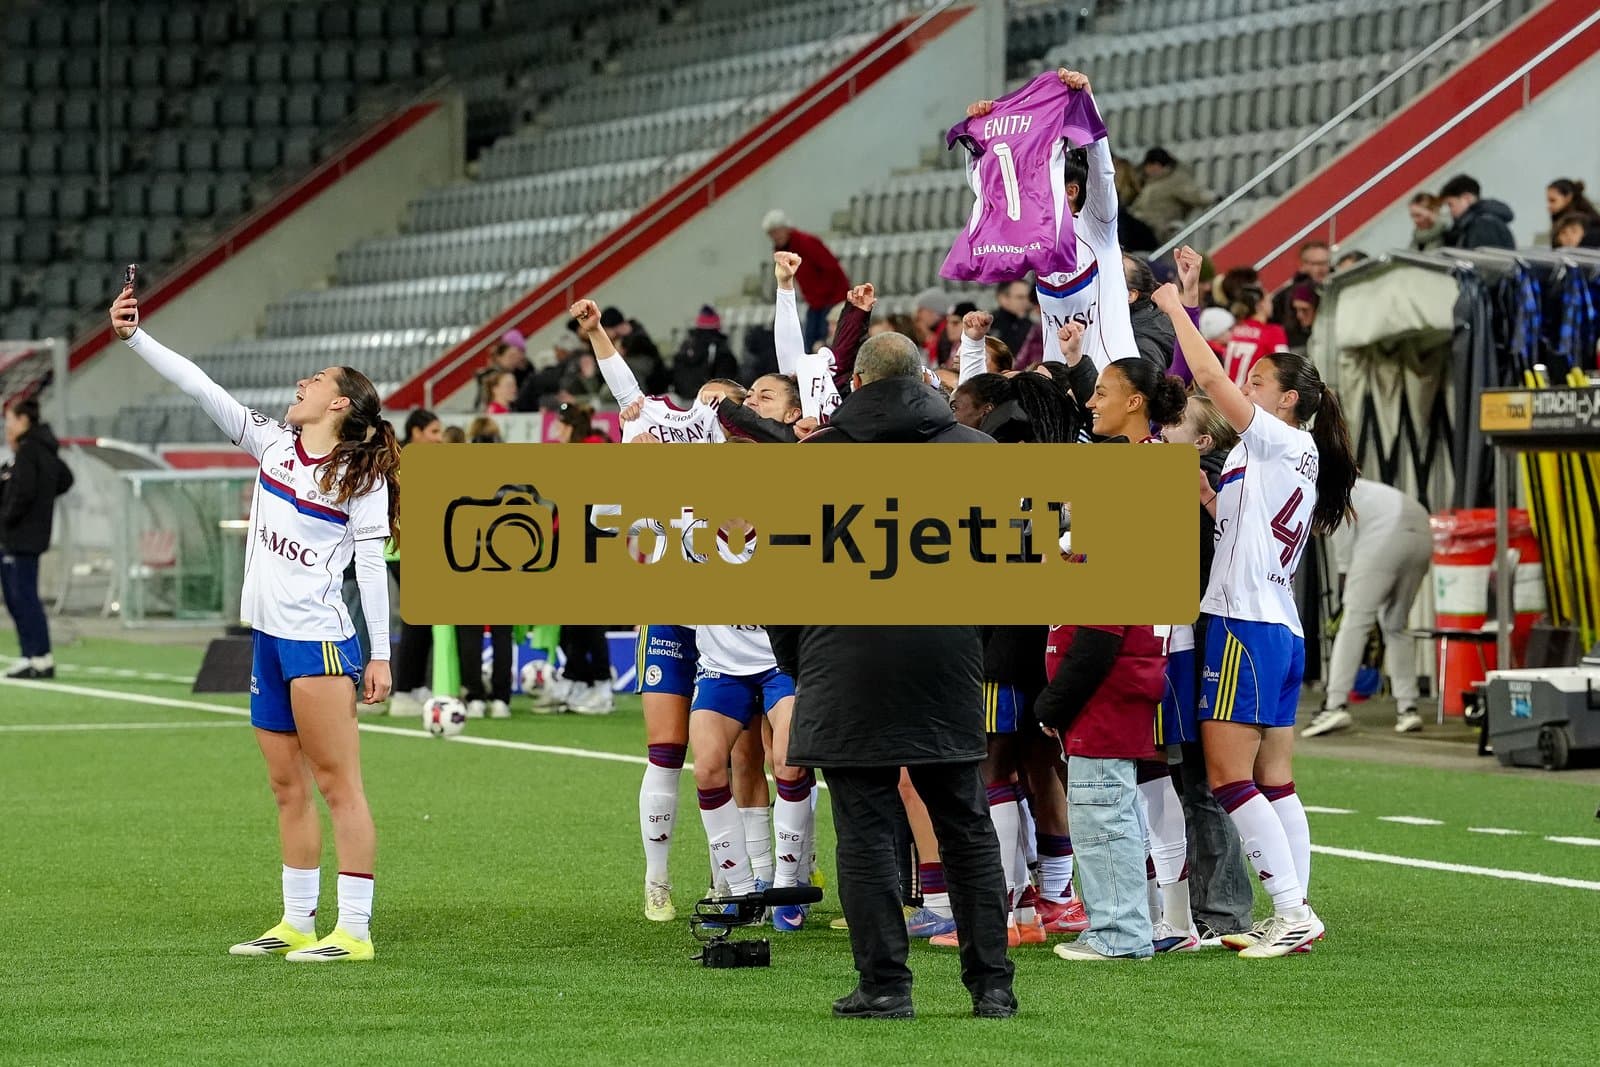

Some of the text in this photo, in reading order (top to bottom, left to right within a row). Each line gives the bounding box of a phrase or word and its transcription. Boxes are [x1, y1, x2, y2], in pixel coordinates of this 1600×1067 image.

[984, 115, 1033, 139] ENITH
[993, 142, 1021, 221] 1
[1270, 486, 1304, 569] 4
[267, 531, 318, 567] MSC
[651, 637, 682, 650] Berney
[648, 813, 671, 823] SFC
[778, 831, 800, 842] SFC
